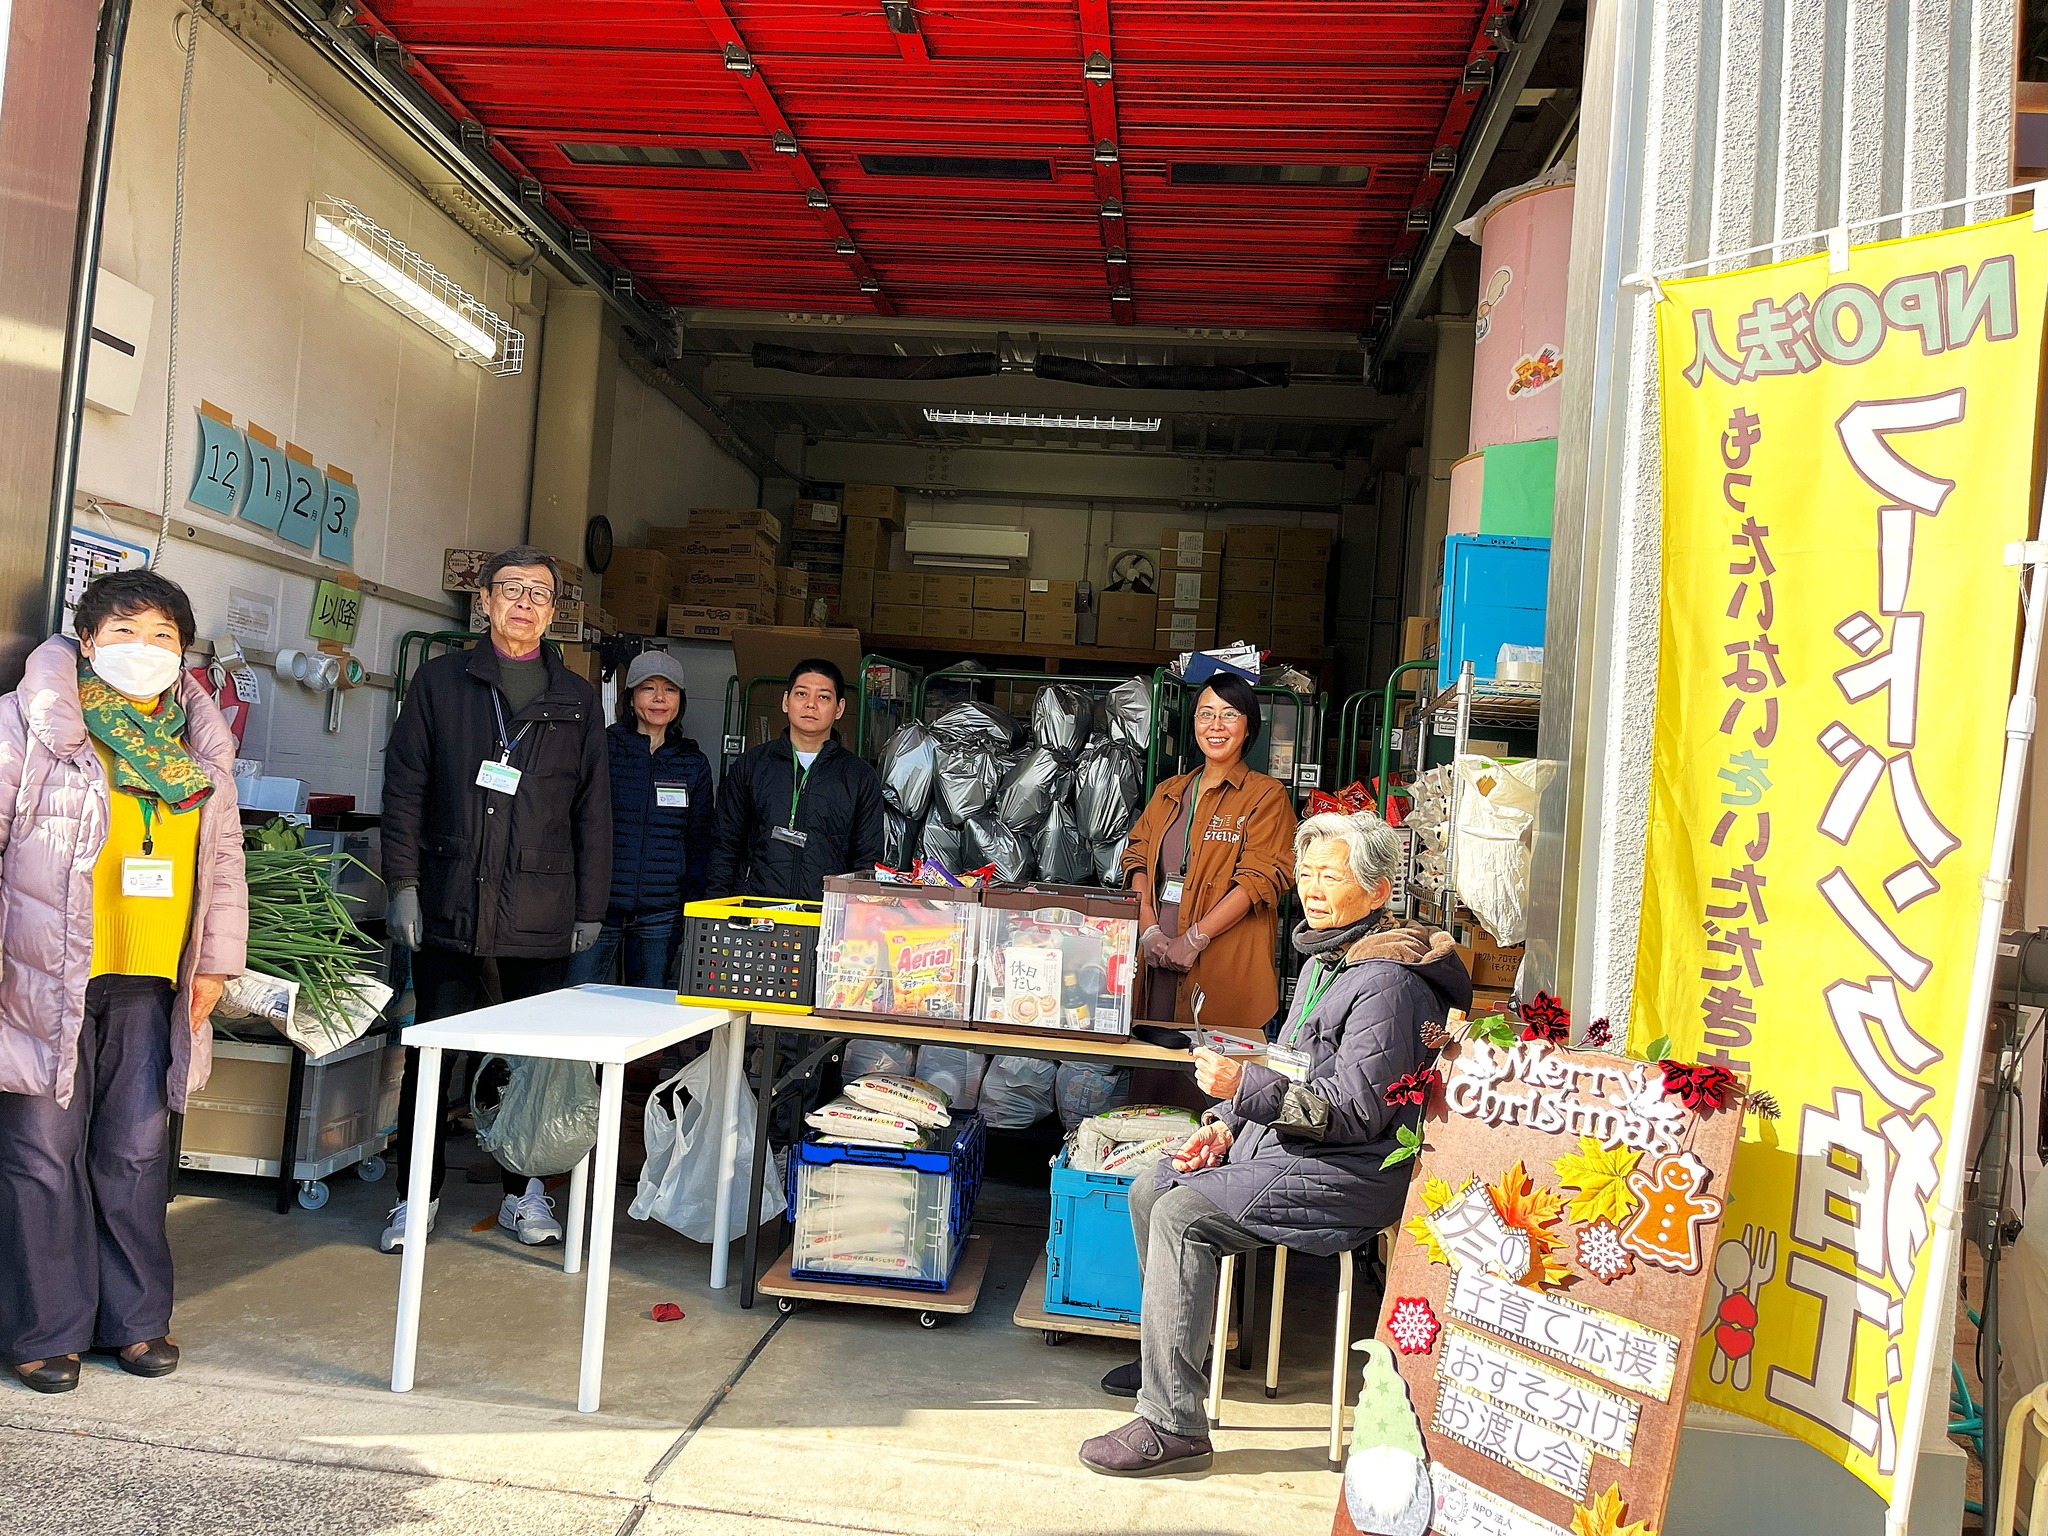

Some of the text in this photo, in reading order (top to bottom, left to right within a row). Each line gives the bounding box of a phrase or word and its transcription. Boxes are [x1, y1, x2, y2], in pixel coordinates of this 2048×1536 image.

[318, 594, 357, 631] 以降
[897, 946, 953, 972] Aerial
[1010, 960, 1037, 978] 休日
[1492, 1041, 1646, 1109] Merry
[1445, 1075, 1682, 1159] Christmas
[1443, 1199, 1525, 1269] 冬の
[1463, 1275, 1658, 1385] 子育て応援
[1451, 1345, 1627, 1441] おすそ分け
[1441, 1392, 1580, 1486] お渡し会
